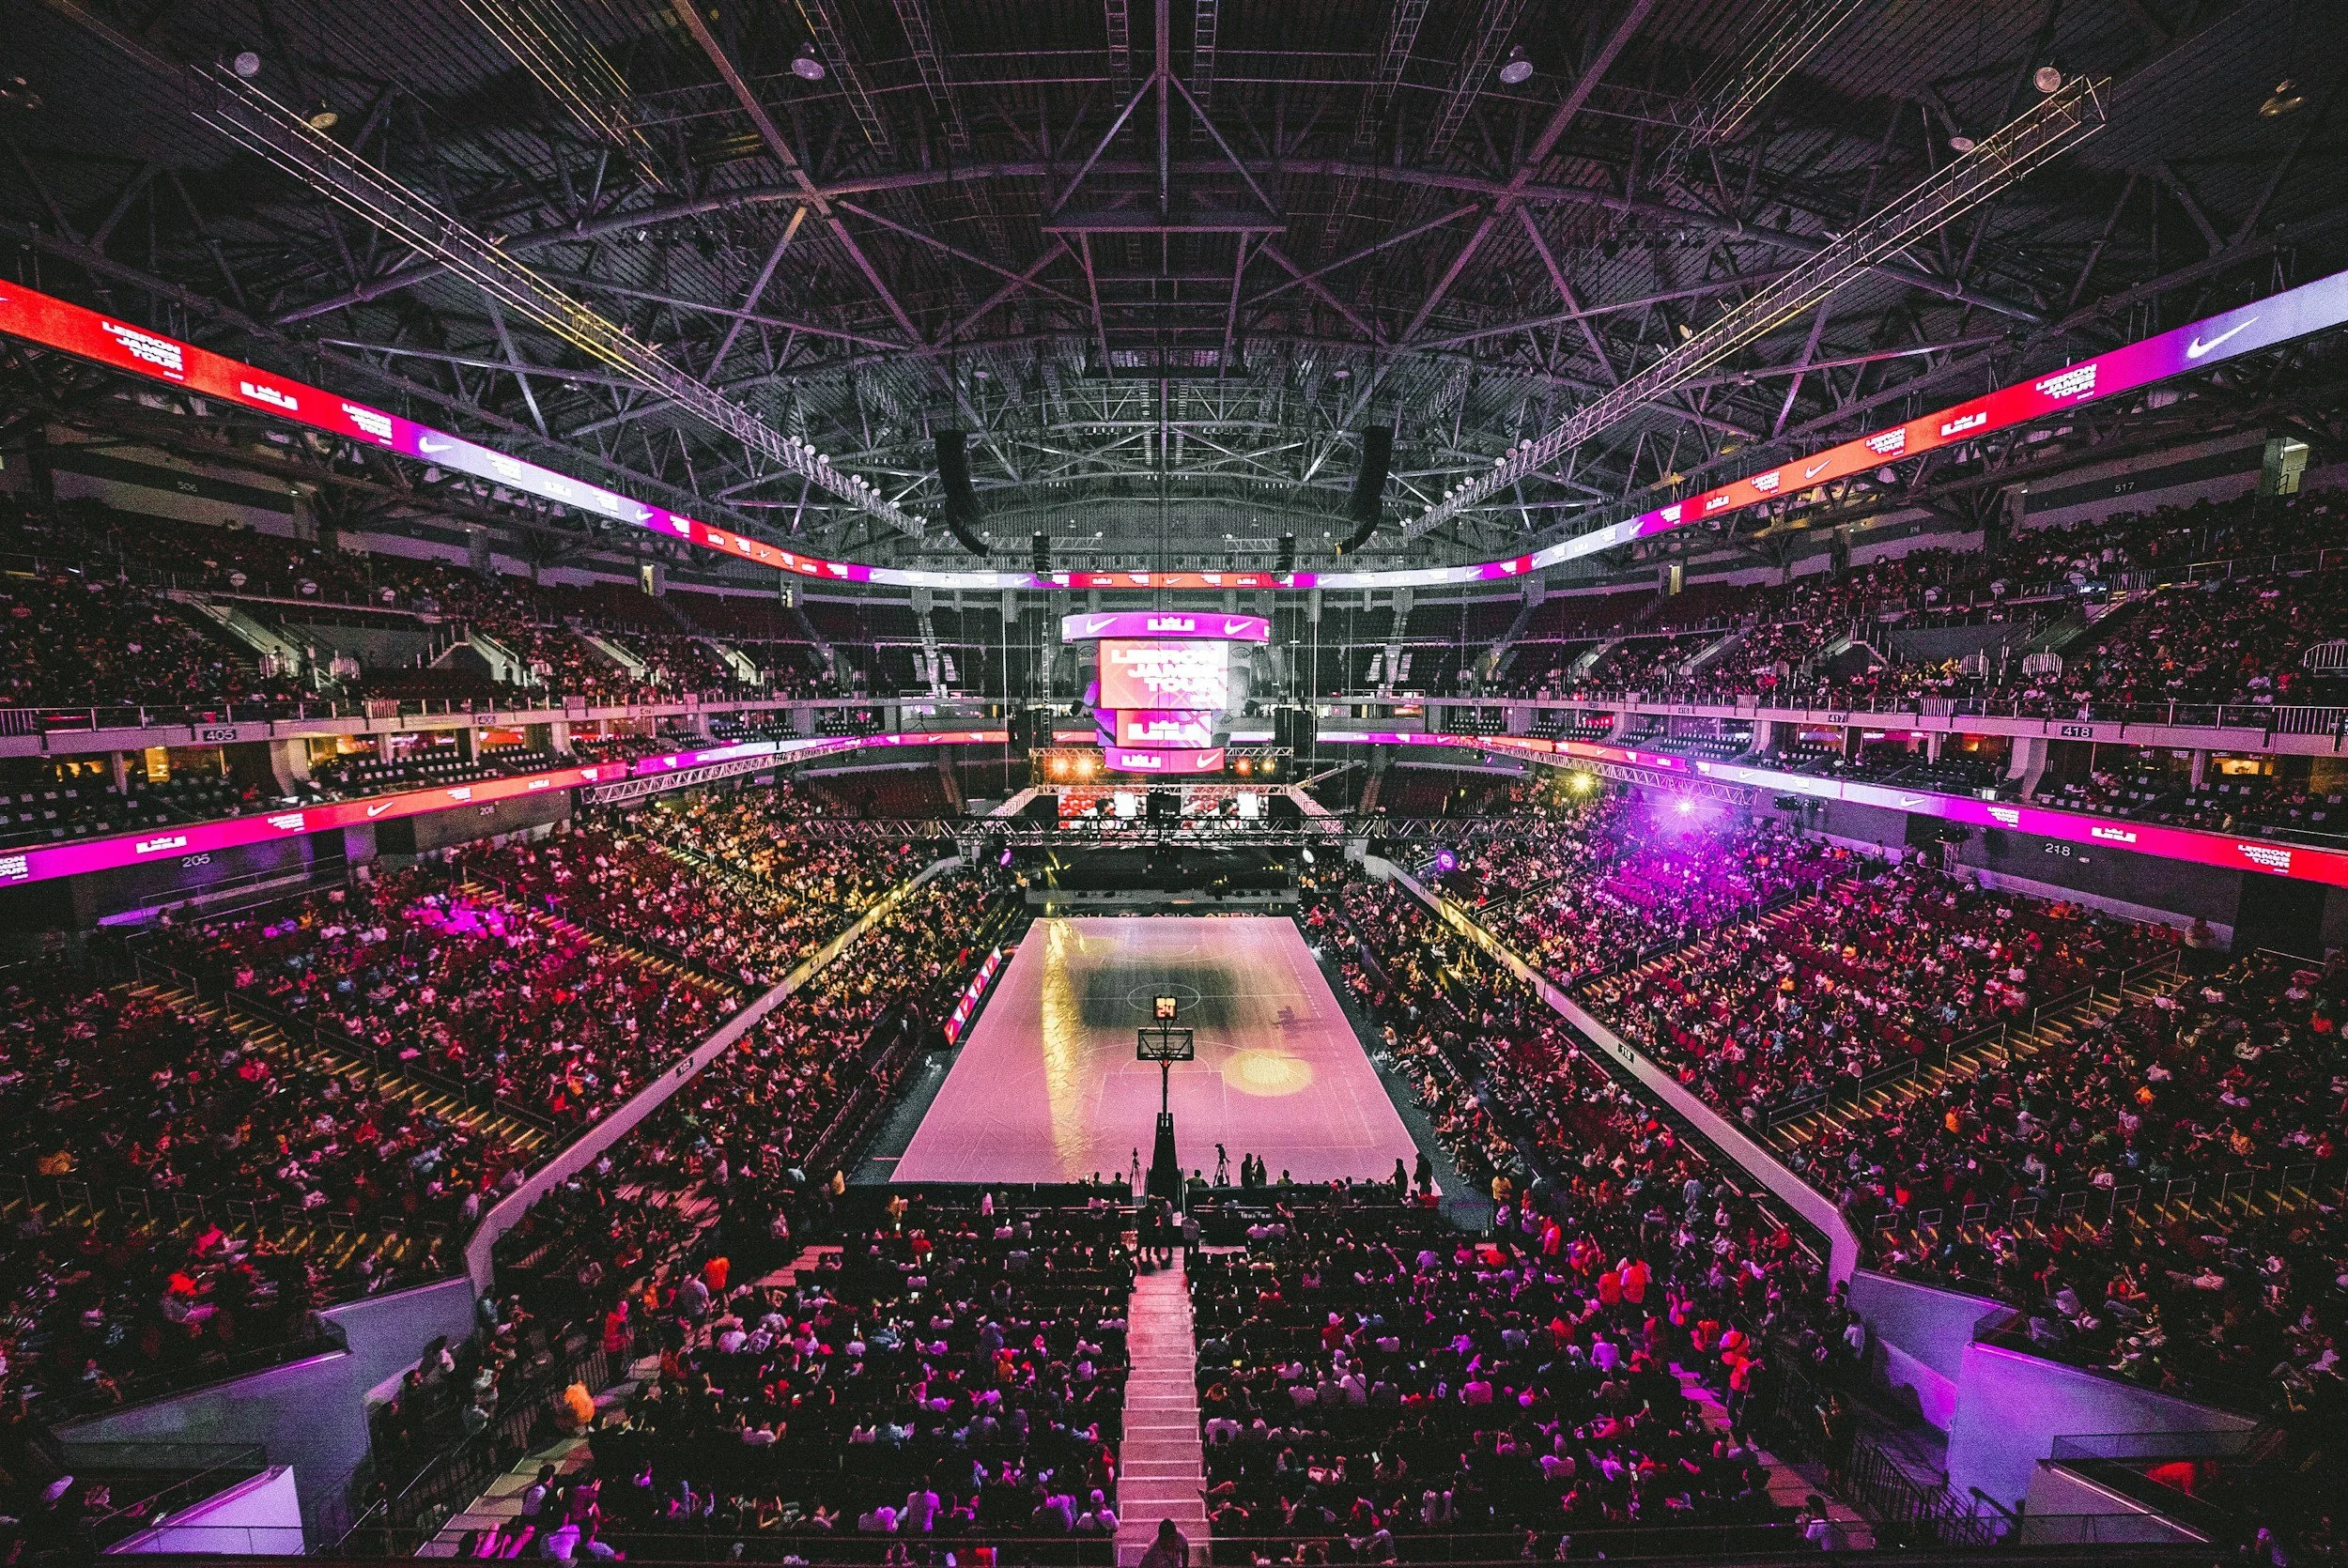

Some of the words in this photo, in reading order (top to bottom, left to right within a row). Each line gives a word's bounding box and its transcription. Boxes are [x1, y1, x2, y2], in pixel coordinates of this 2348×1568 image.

[101, 320, 181, 355] LEBRON
[116, 336, 182, 363] JAMES
[129, 346, 183, 372] TOUR
[2035, 363, 2097, 391] LEBRON
[2044, 372, 2096, 395] JAMES
[2051, 379, 2095, 399] TOUR
[1865, 427, 1906, 447] LEBRON
[1877, 439, 1905, 454] TOUR
[2114, 482, 2135, 493] 517
[1111, 649, 1223, 664] LEBRON
[1127, 663, 1222, 678] JAMES
[1143, 677, 1220, 692] TOUR
[207, 730, 235, 740] 405
[2063, 727, 2090, 737] 418
[2045, 842, 2071, 856] 218
[2237, 845, 2292, 858] LEBRON
[181, 853, 210, 868] 205
[2245, 852, 2291, 862] JAMES
[2252, 856, 2290, 869] TOUR
[1156, 1005, 1175, 1018] 24
